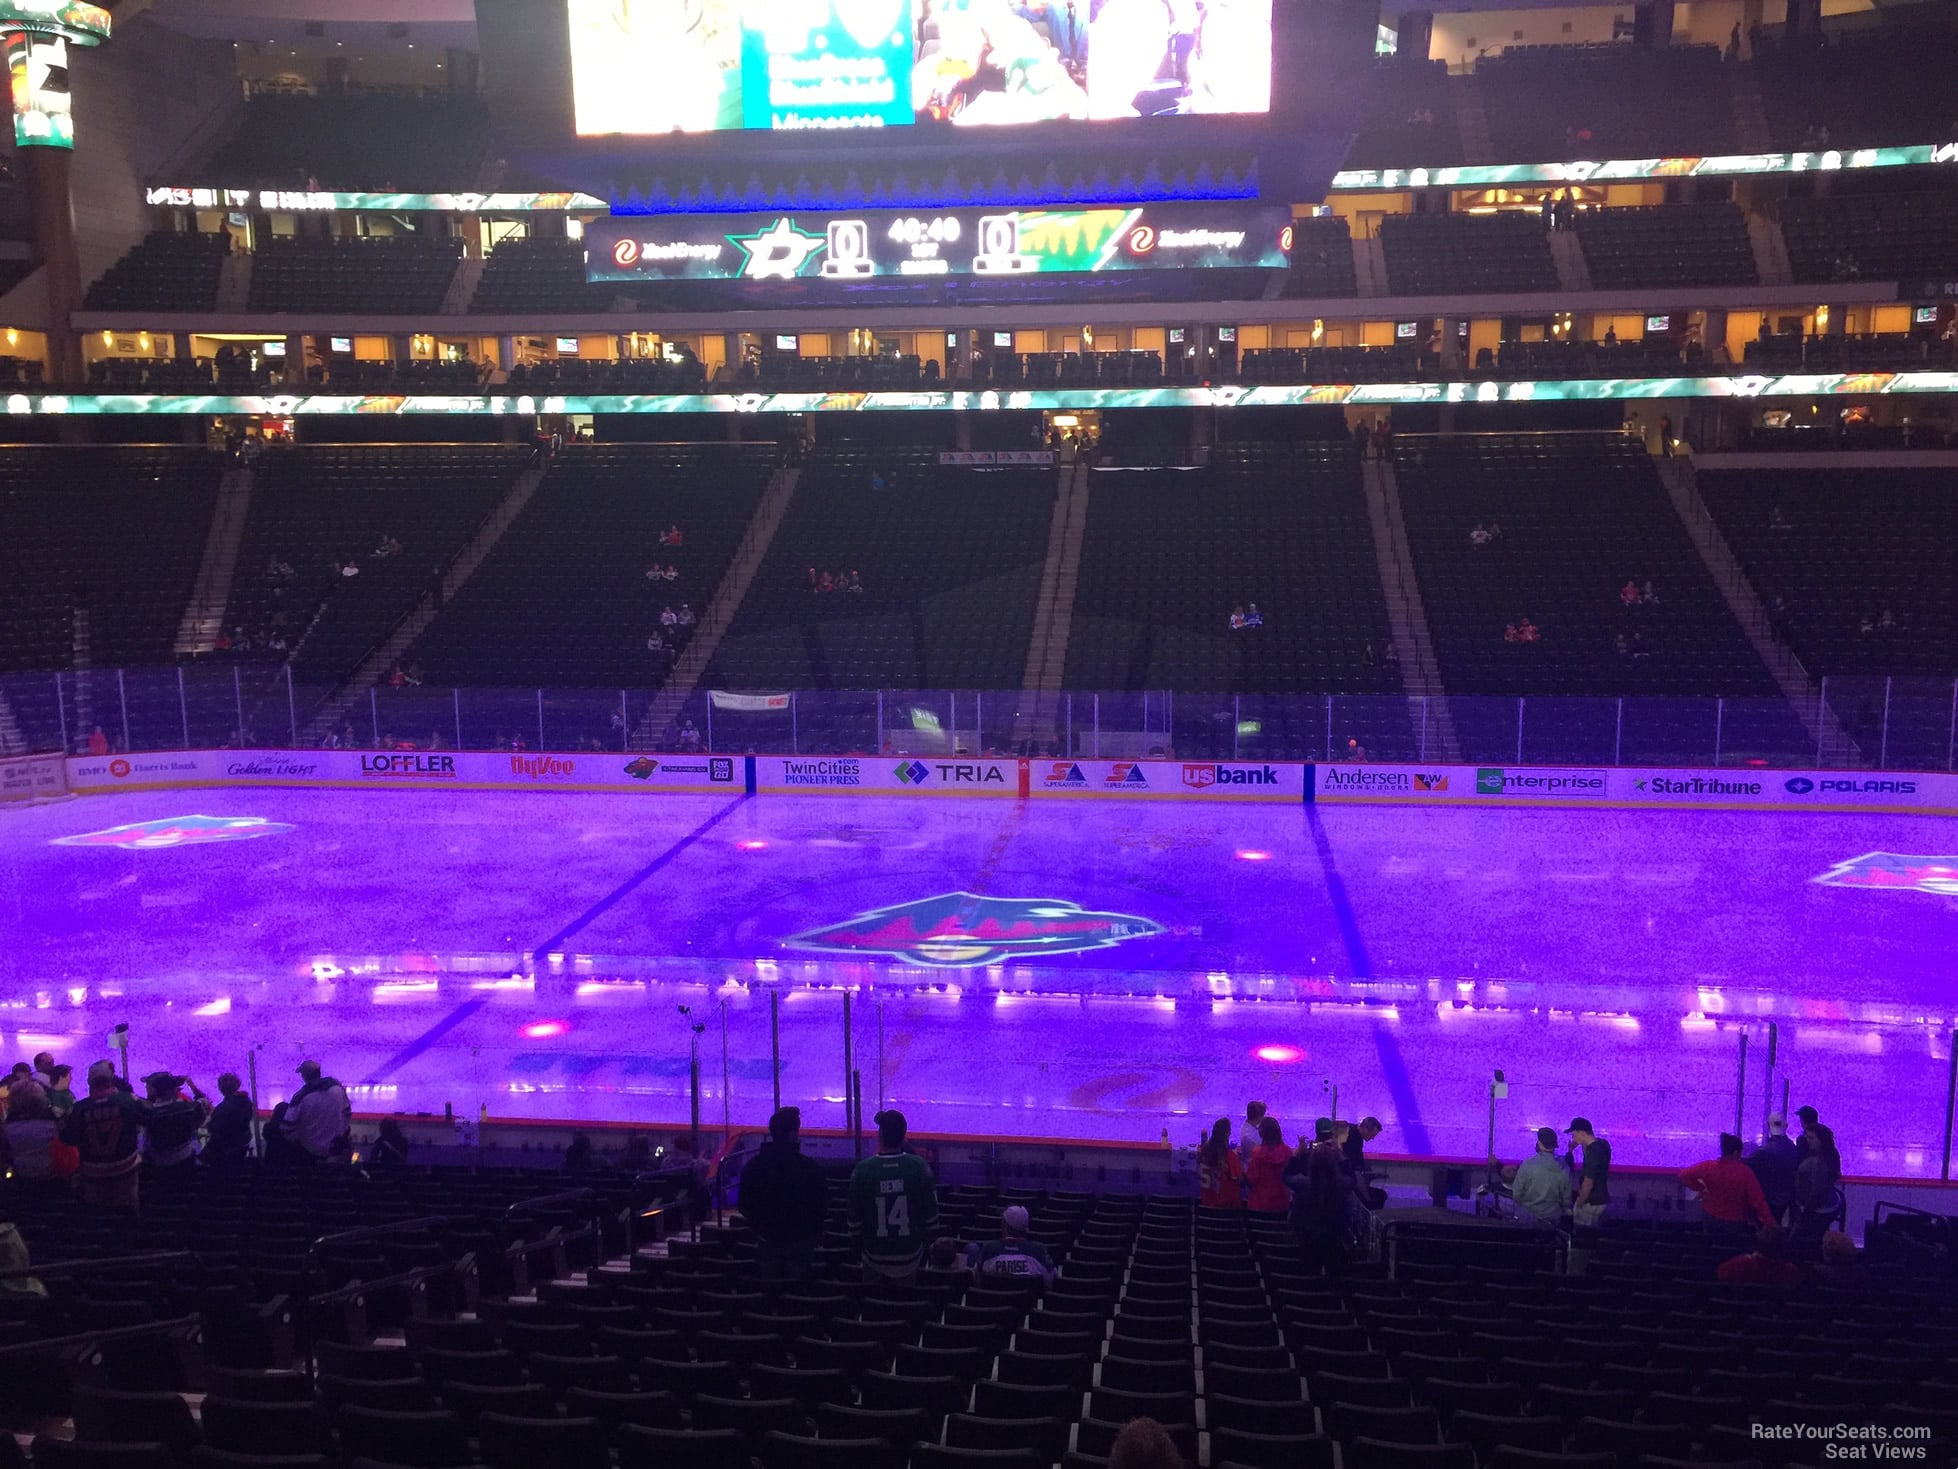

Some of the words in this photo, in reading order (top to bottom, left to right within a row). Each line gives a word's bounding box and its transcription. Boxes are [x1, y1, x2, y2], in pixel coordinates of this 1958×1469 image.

[888, 216, 961, 242] 40:40
[227, 762, 273, 775] Golden
[276, 765, 317, 775] LIGHT
[361, 755, 456, 771] LOFFLER
[713, 760, 729, 769] FOX
[782, 760, 860, 775] TwinCities
[785, 775, 828, 785] PIONEER
[829, 775, 860, 785] PRESS
[936, 765, 1005, 782] TRIA
[1326, 768, 1409, 785] Andersen
[1819, 780, 1916, 793] POLARIS
[875, 1195, 910, 1237] 14
[996, 1260, 1028, 1273] PARISE
